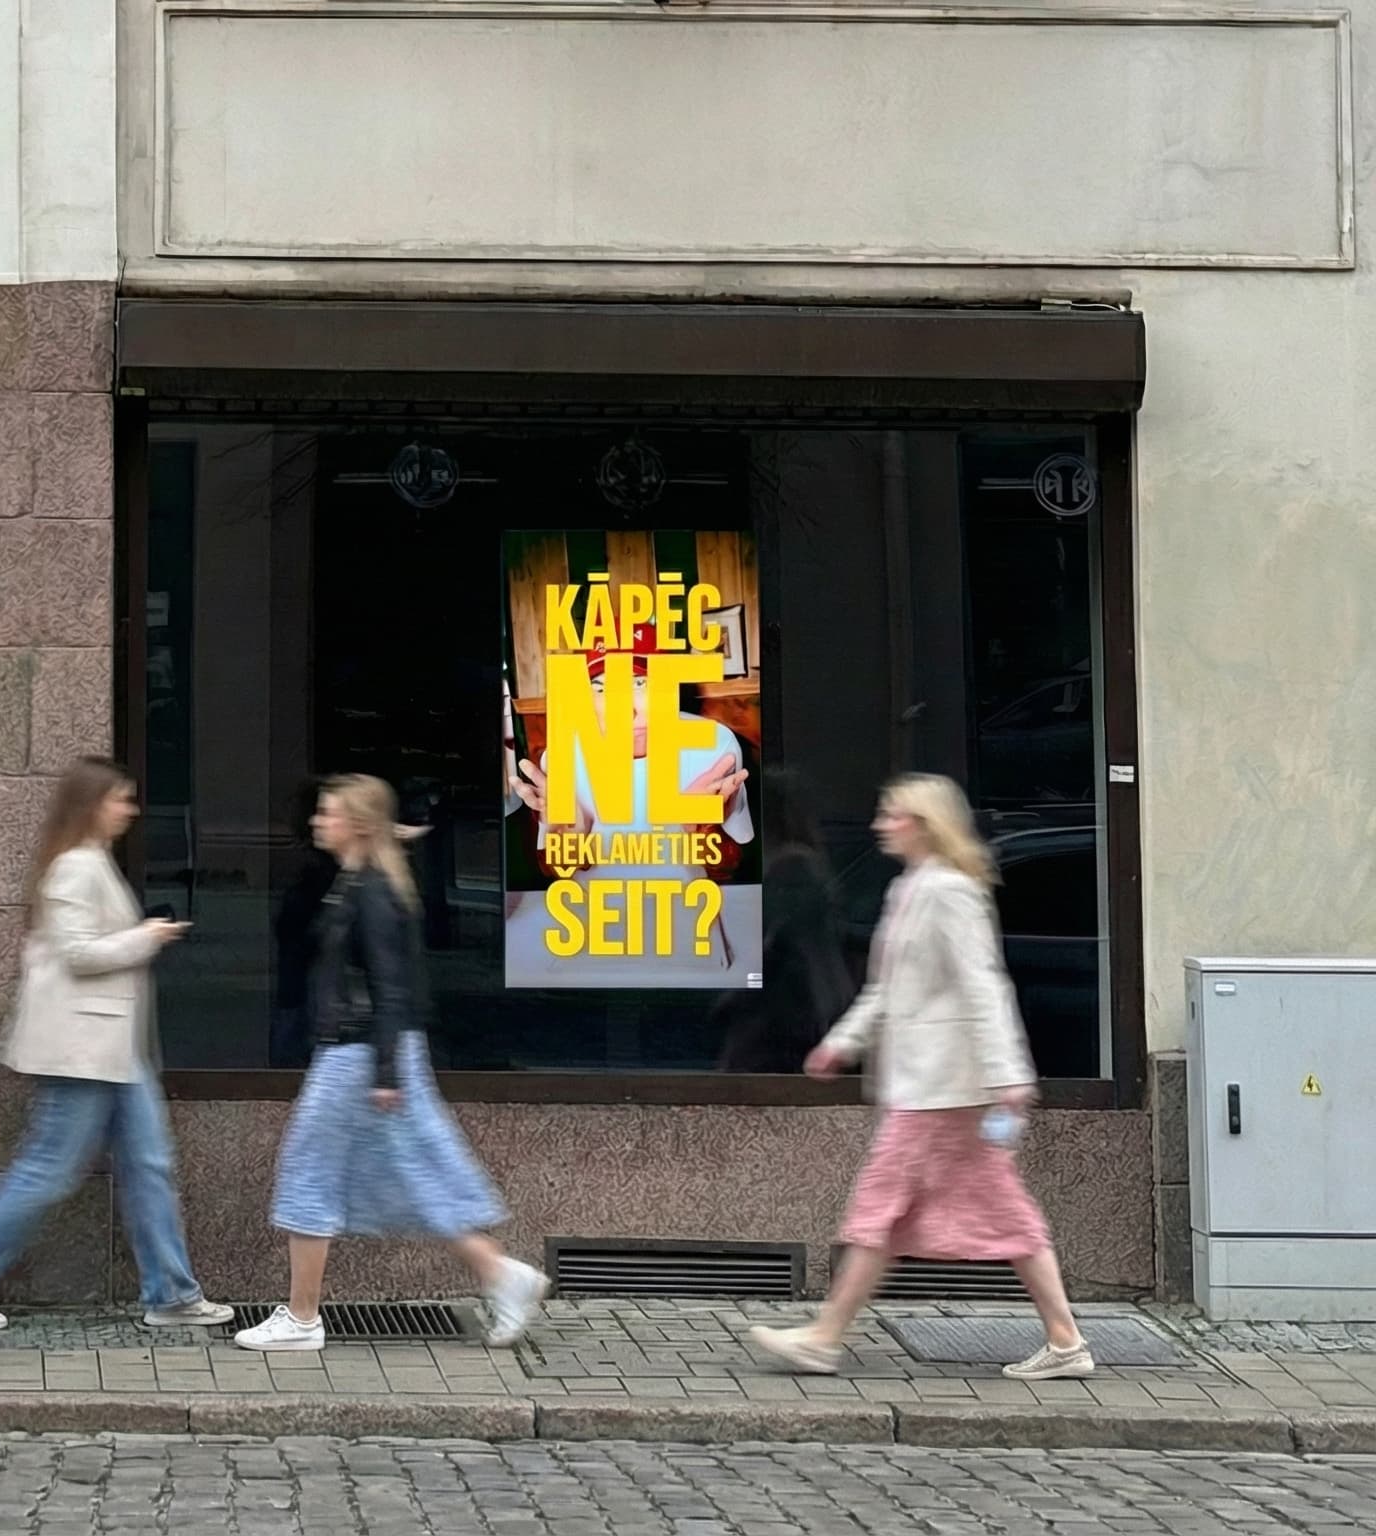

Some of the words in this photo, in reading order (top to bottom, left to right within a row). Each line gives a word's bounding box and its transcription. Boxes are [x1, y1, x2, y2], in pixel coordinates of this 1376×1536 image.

[545, 572, 722, 651] KĀPĒC
[546, 653, 724, 825] NE
[545, 825, 723, 866] REKLAMĒTIES
[545, 866, 723, 957] ŠEIT?
